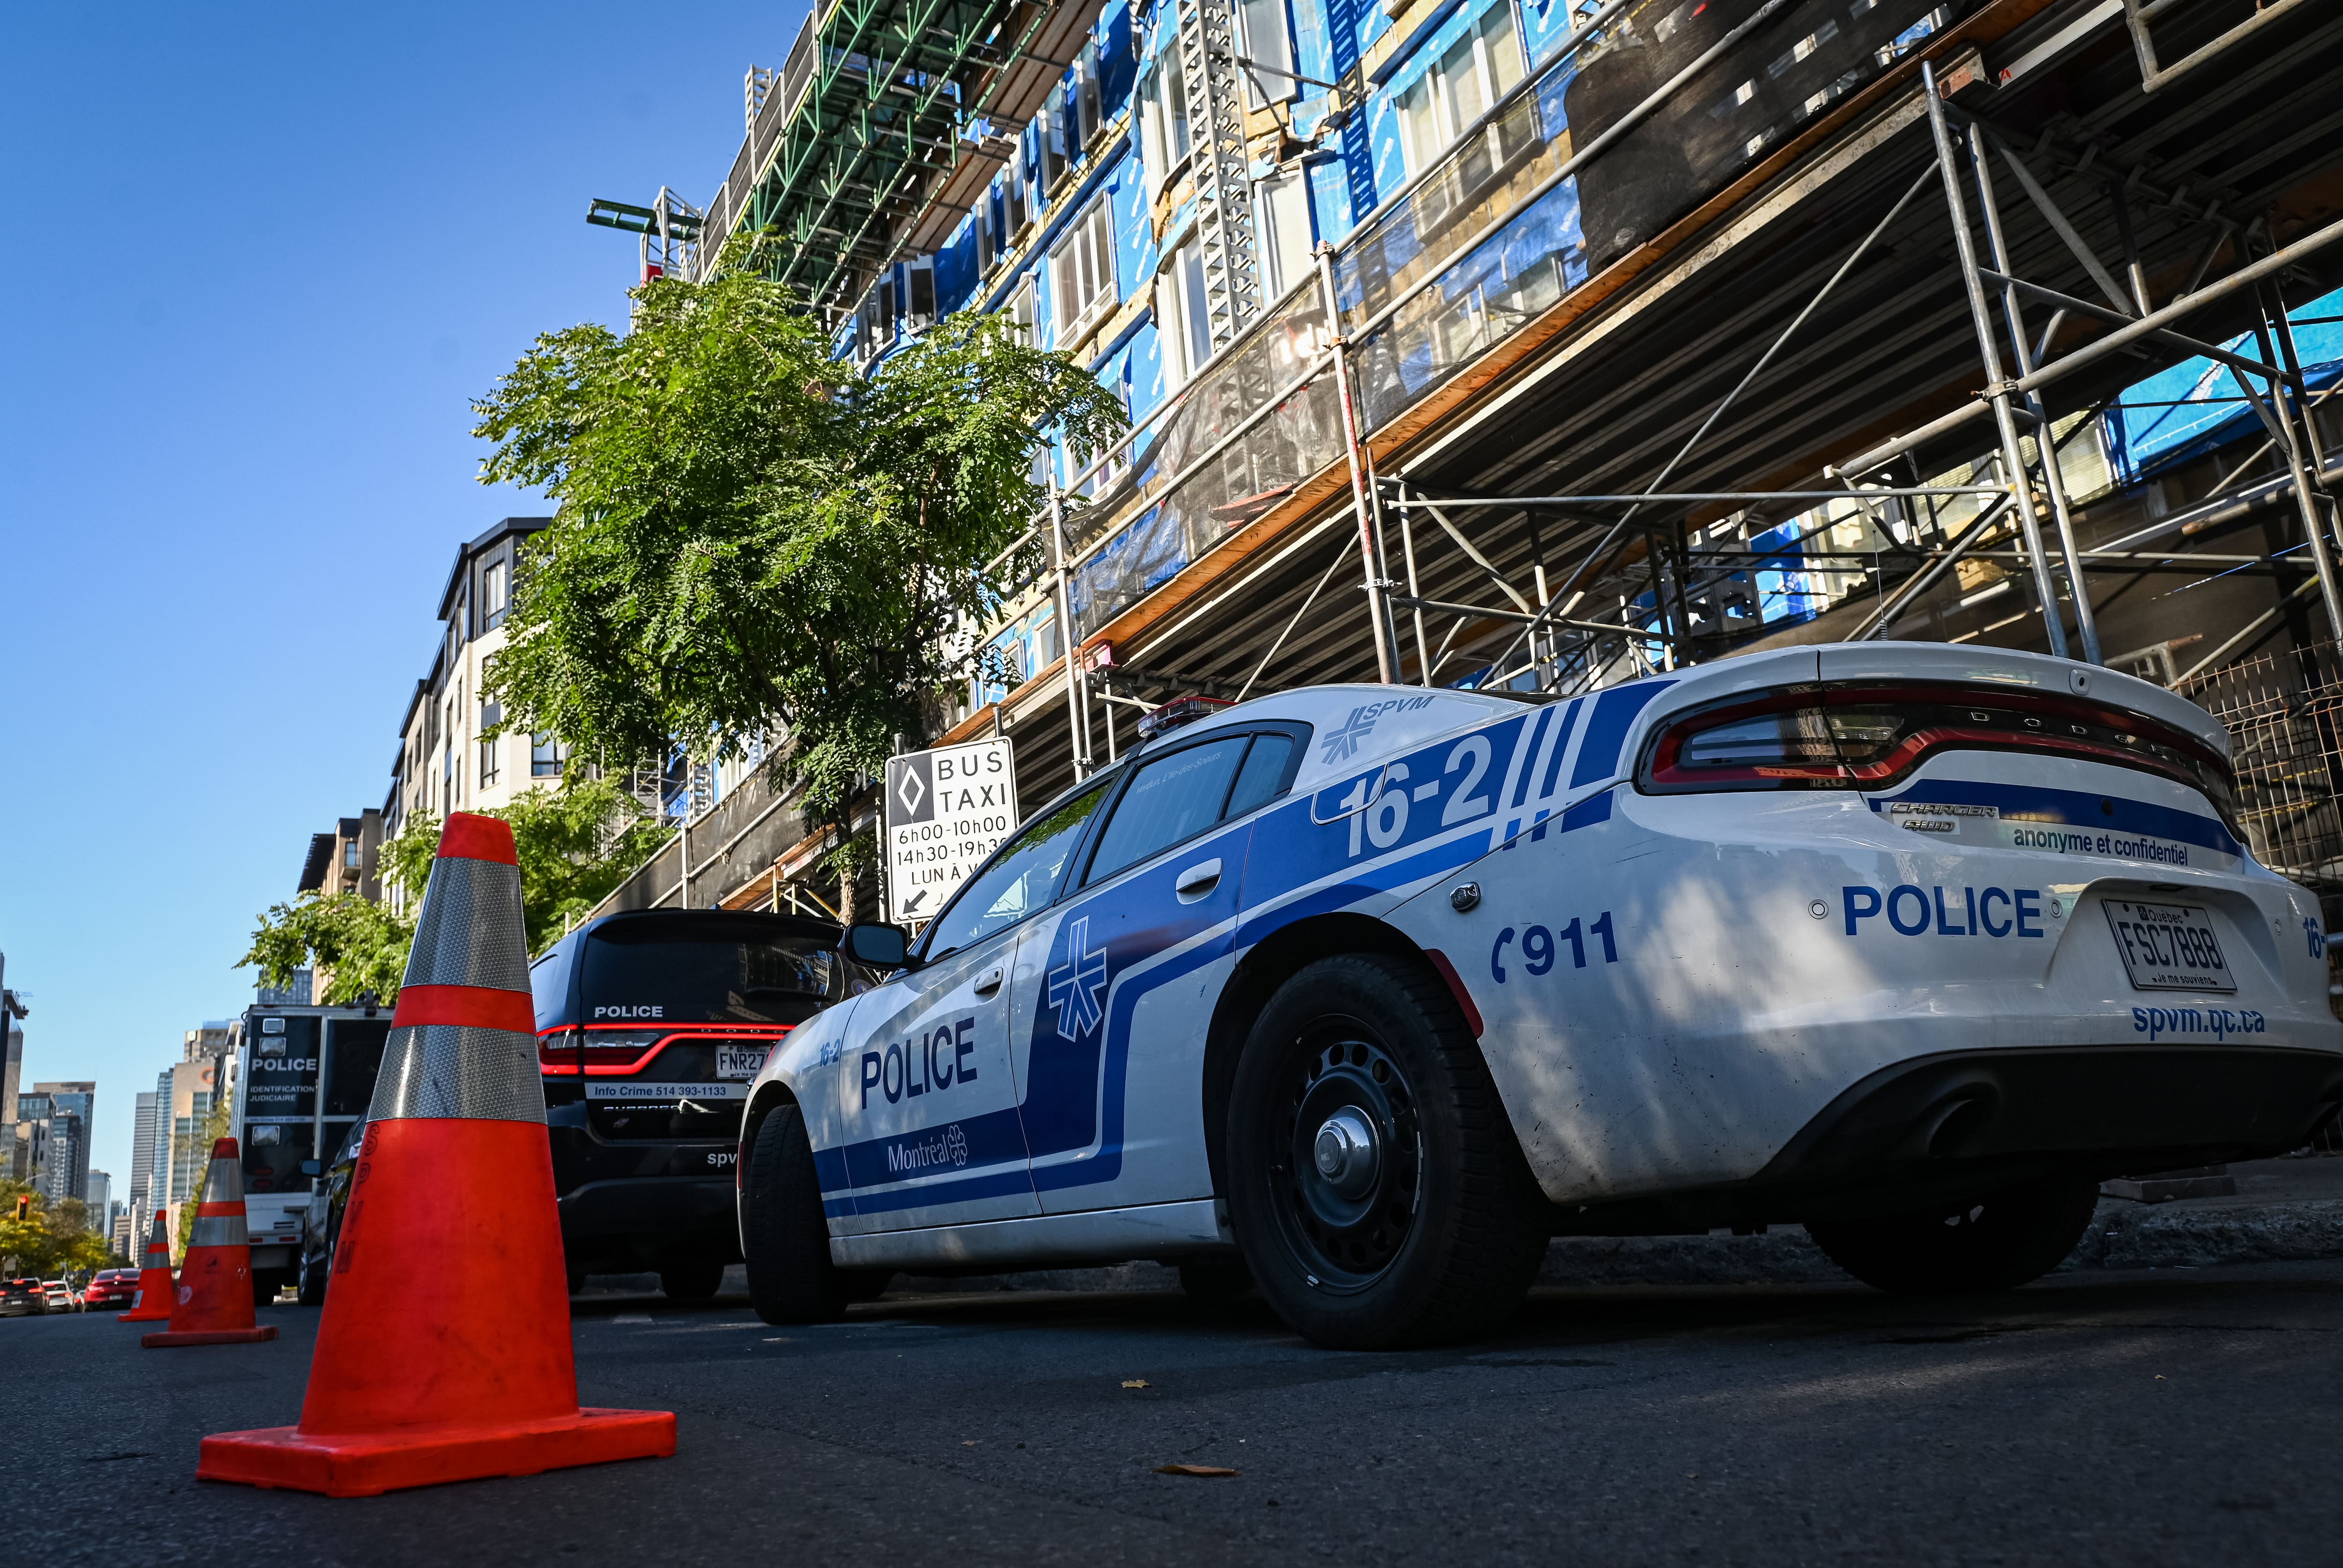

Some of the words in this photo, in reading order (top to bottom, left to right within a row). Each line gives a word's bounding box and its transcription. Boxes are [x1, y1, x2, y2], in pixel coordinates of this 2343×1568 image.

[1363, 696, 1436, 721] SPVM
[939, 751, 1002, 780] BUS
[940, 783, 1005, 812] TAXI
[1340, 734, 1492, 858] 16-2
[1891, 802, 1997, 817] CHARGER
[899, 816, 1006, 844] 6h00-10h00
[1903, 819, 1956, 832] AWD
[2014, 828, 2092, 854] anonyme
[2097, 837, 2111, 854] et
[2115, 838, 2188, 866] confidentiel
[912, 867, 944, 885] LUN
[1842, 884, 2044, 938] POLICE
[2148, 910, 2183, 924] Québec
[1522, 910, 1619, 976] 911
[2117, 921, 2223, 969] FSC7888
[2302, 917, 2327, 960] 16-
[2157, 973, 2166, 982] Je
[2180, 973, 2213, 985] souviens
[595, 1005, 663, 1018] POLICE
[2133, 1006, 2265, 1041] spvm.qc.ca
[252, 1058, 317, 1071] POLICE
[719, 1053, 770, 1070] FNR27
[819, 1038, 840, 1067] 16-2
[861, 1017, 977, 1110] POLICE
[250, 1085, 315, 1094] IDENTIFICATION
[594, 1086, 618, 1096] Info
[619, 1086, 653, 1096] Crime
[656, 1086, 675, 1096] 514
[678, 1086, 726, 1096] 393-1133
[707, 1153, 738, 1168] spv
[888, 1135, 949, 1173] Montréal
